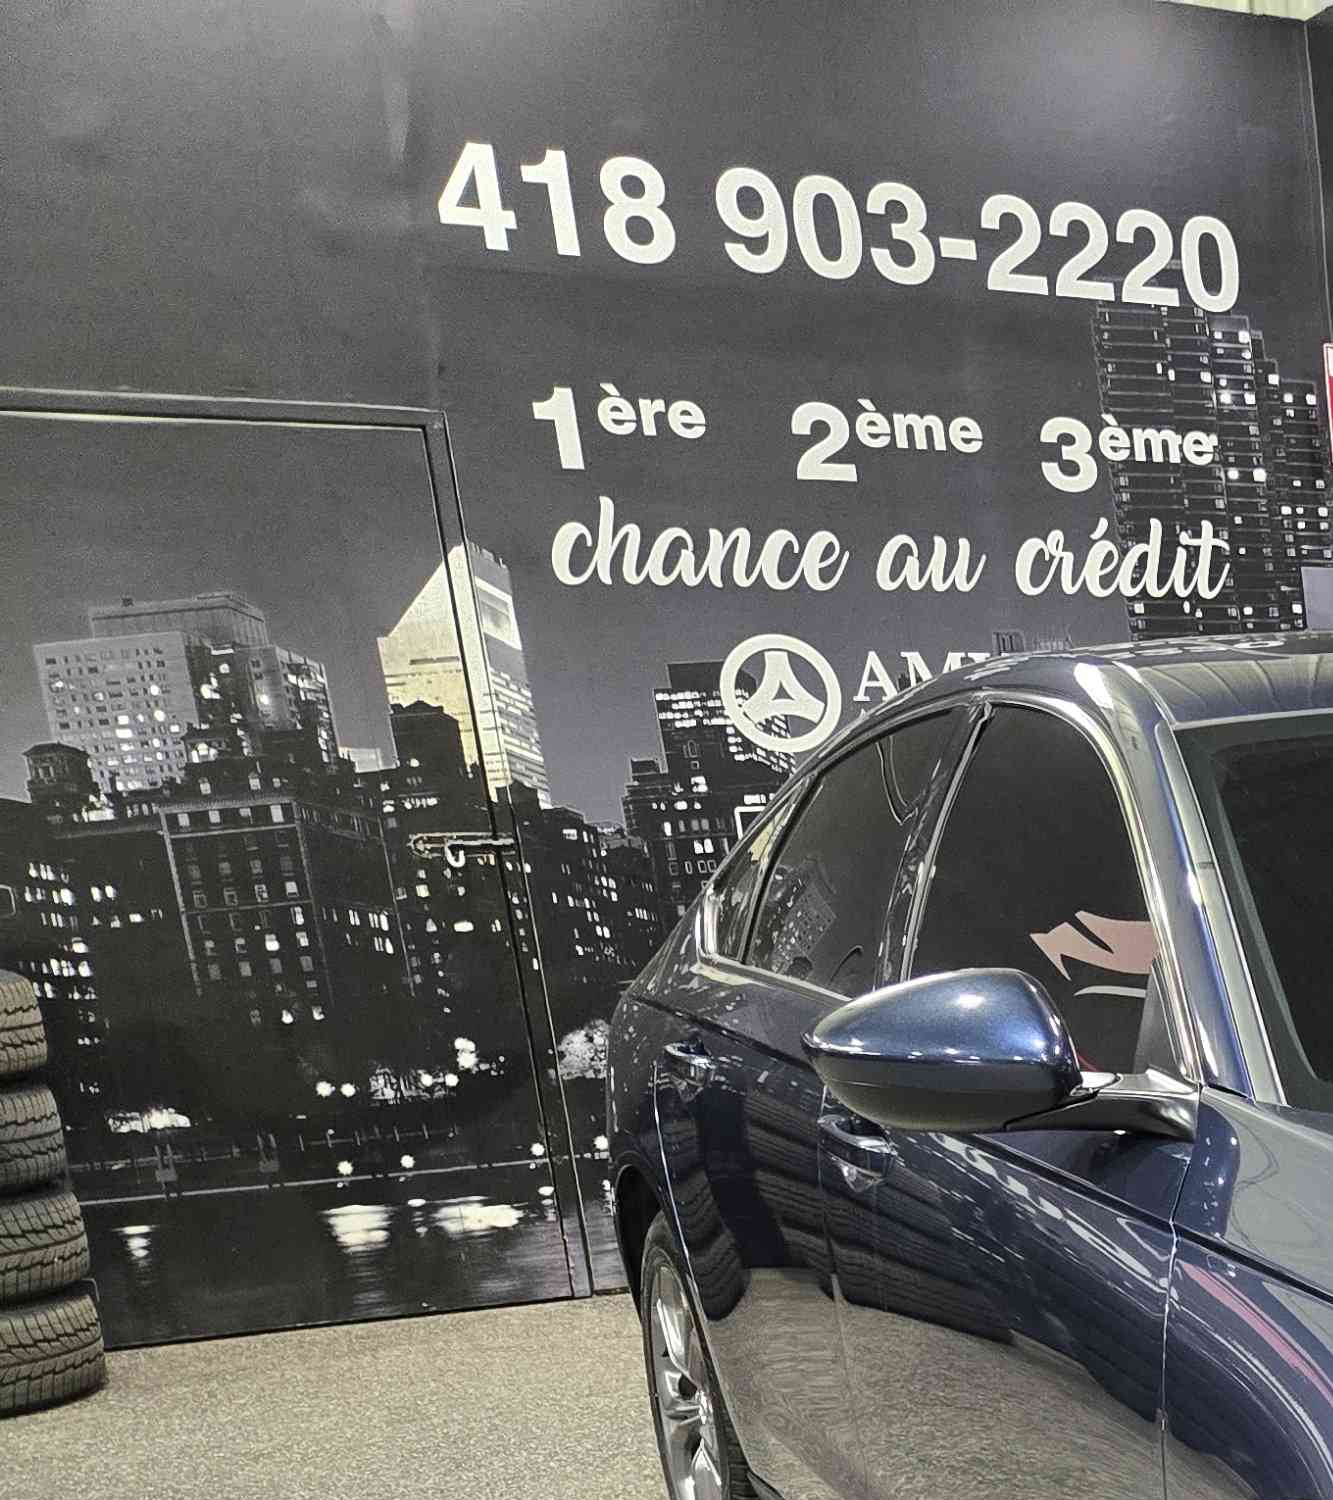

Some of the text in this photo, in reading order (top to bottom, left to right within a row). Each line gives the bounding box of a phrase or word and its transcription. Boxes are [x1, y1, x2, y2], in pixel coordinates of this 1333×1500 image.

[437, 141, 1239, 313] 418 903-2220
[532, 382, 1218, 493] 1ère 2ème 3ème
[551, 495, 1230, 599] chance au crédit
